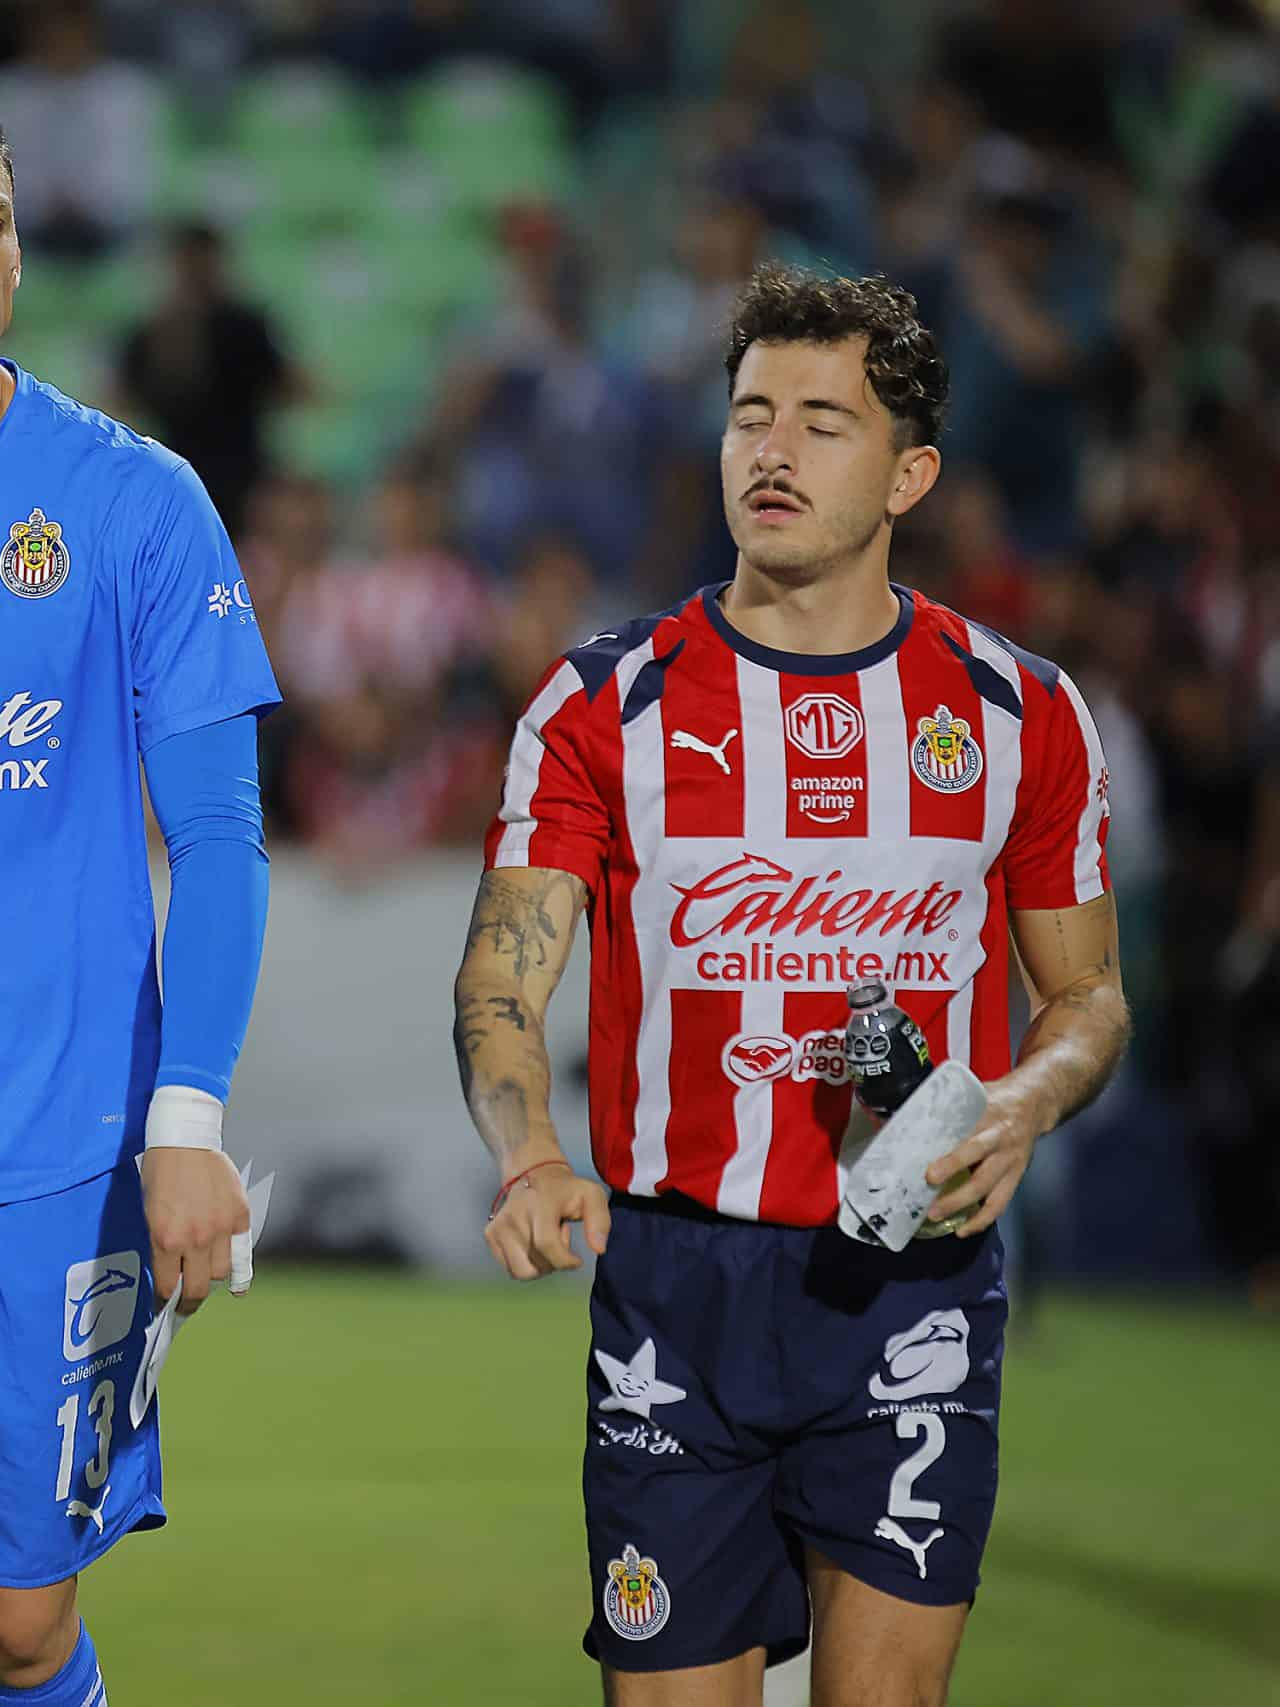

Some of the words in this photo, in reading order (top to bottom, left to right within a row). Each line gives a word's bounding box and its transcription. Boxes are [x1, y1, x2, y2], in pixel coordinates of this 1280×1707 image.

[794, 700, 856, 752] MG
[791, 775, 864, 791] amazon
[799, 791, 856, 813] prime
[669, 852, 964, 948] Caliente
[697, 942, 953, 983] caliente.mx
[799, 1055, 846, 1079] pag
[61, 1351, 124, 1386] caliente.mx
[55, 1379, 116, 1502] 13
[888, 1411, 946, 1521] 2
